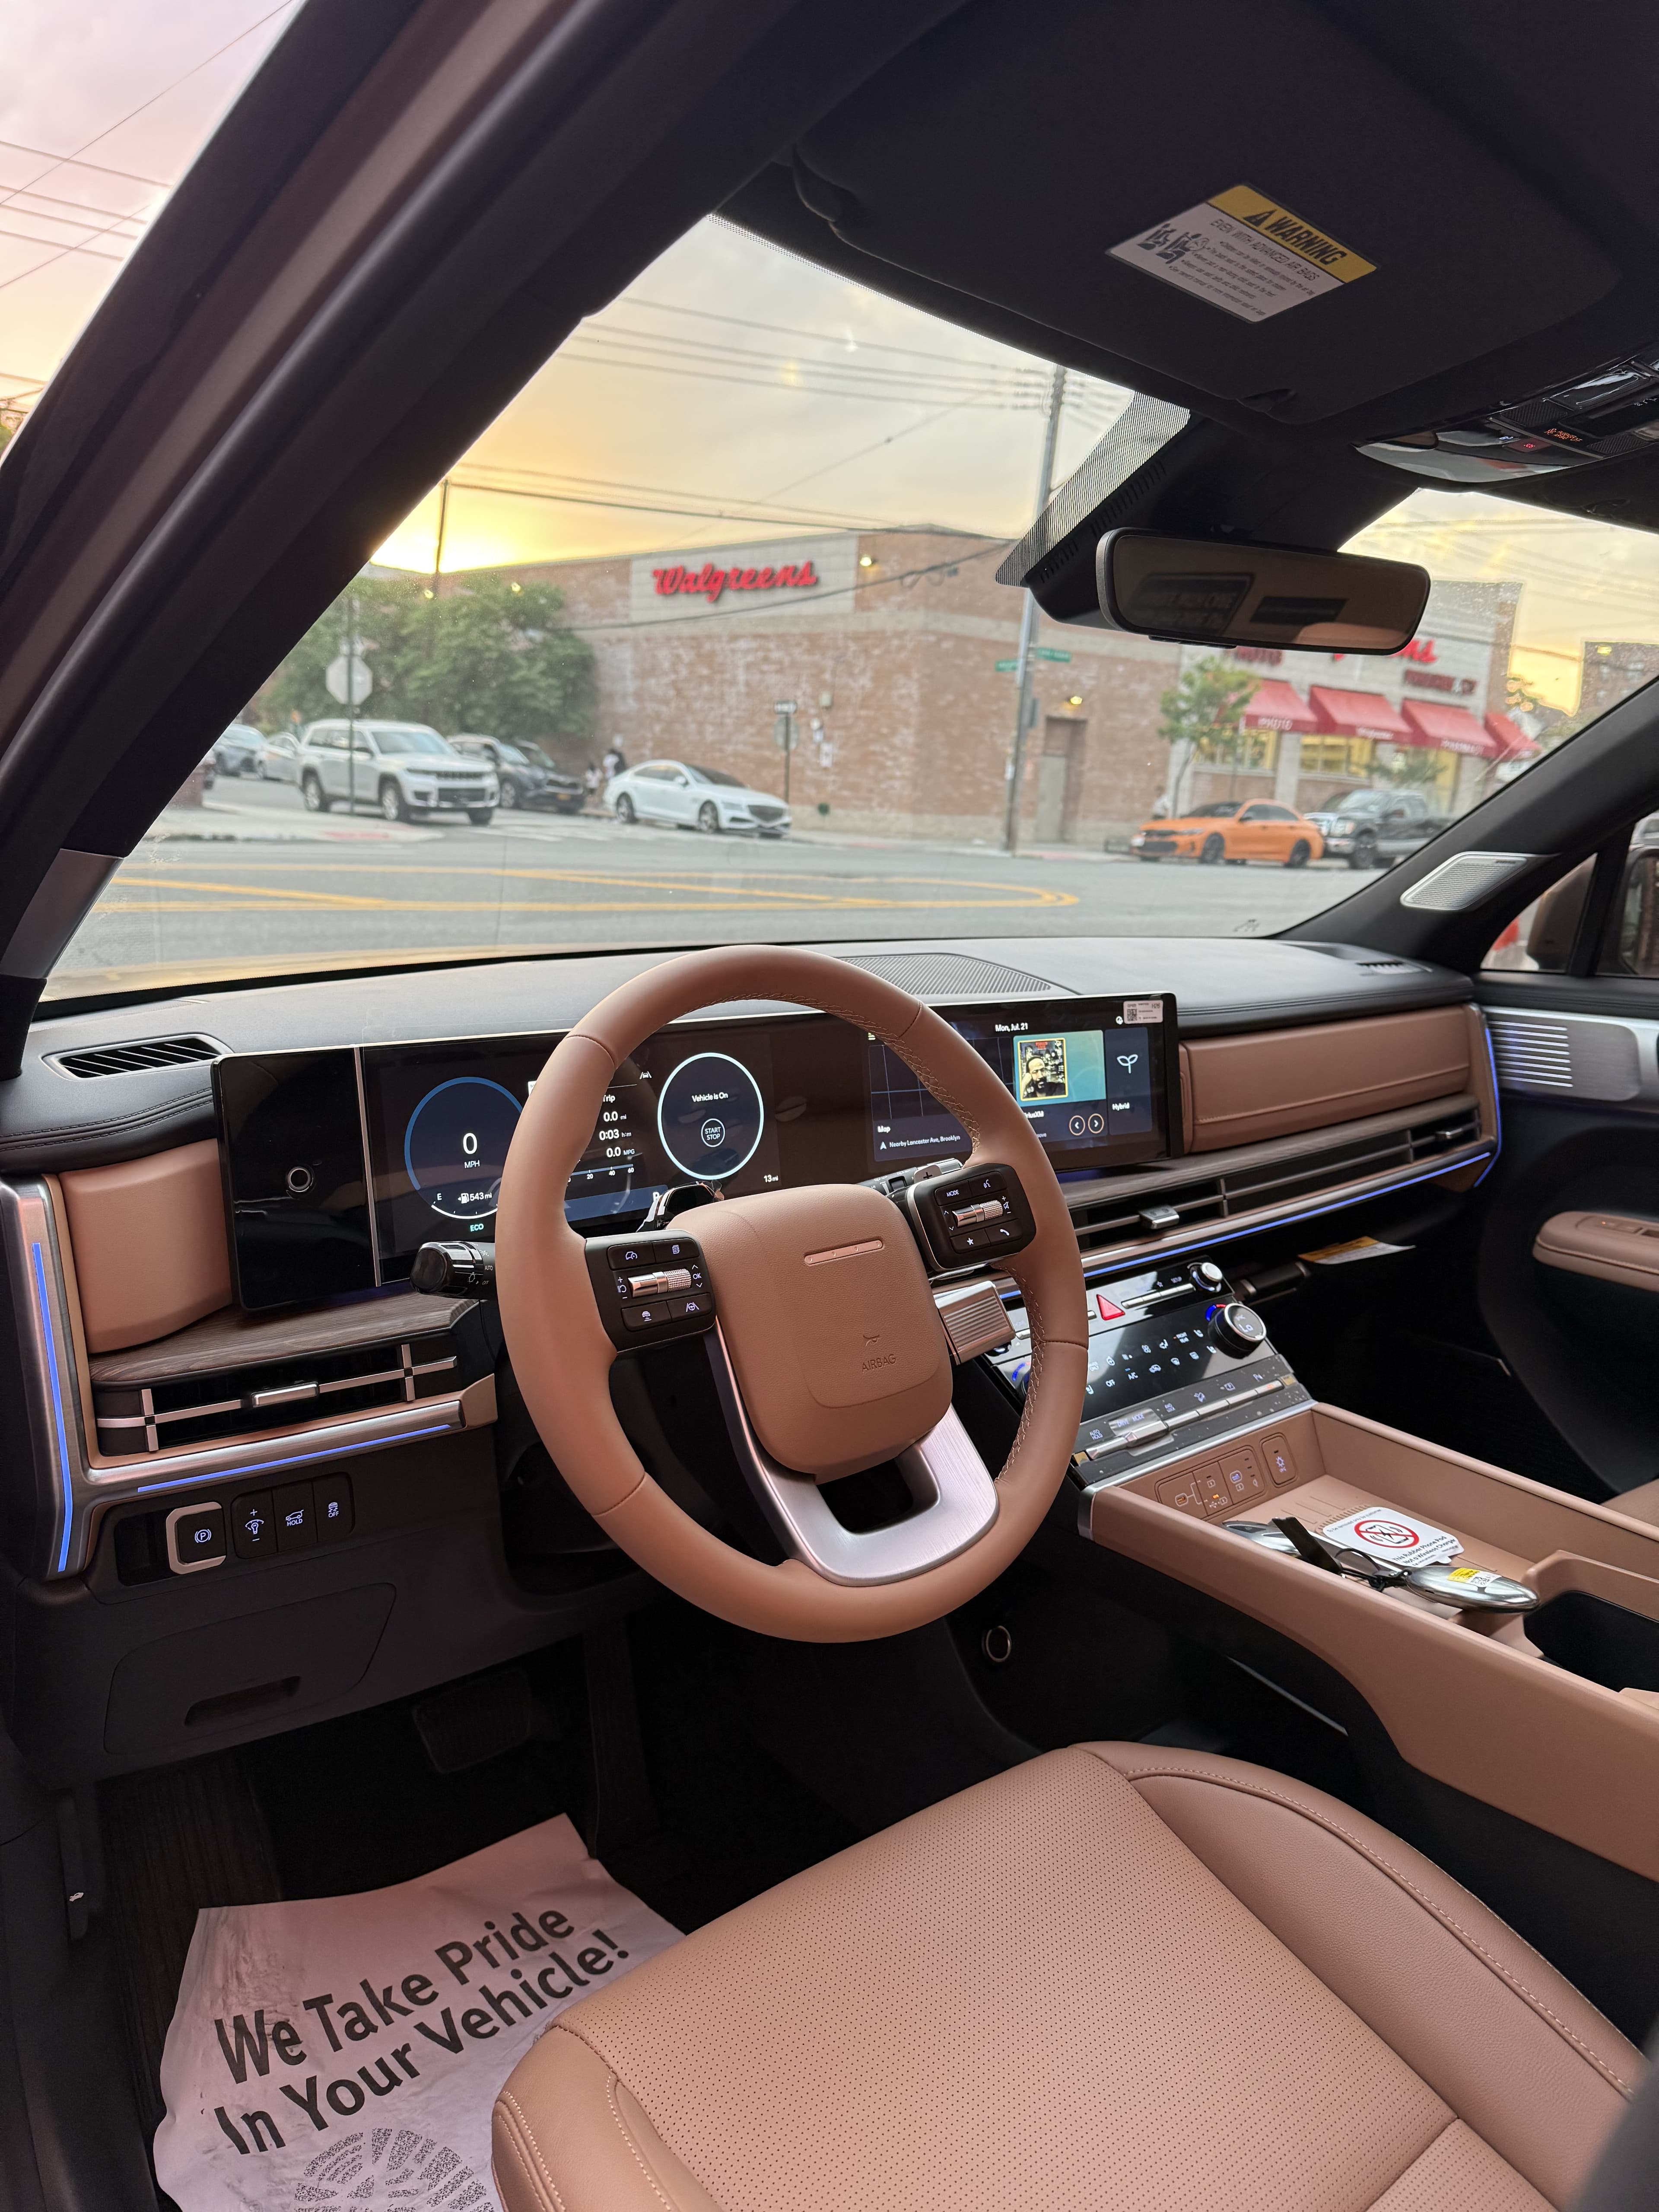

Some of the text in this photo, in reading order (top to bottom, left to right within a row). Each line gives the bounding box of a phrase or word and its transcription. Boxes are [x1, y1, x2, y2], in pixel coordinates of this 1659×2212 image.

[1264, 216, 1348, 265] WARNING
[1210, 219, 1320, 281] EVEN WITH ADVANCED AIR BAGS
[652, 560, 817, 604] Walgreens
[1112, 1103, 1130, 1111] Hybrid
[604, 1111, 618, 1122] 0.0
[599, 1129, 620, 1141] 0:03
[463, 1133, 477, 1154] 0
[606, 1147, 621, 1157] 0.0
[464, 1160, 480, 1169] MPH
[470, 1224, 484, 1232] ECO
[862, 1354, 896, 1372] AIRBAG
[1132, 1413, 1144, 1421] MODE
[214, 1909, 575, 2084] We Take Pride
[213, 1930, 629, 2155] In Your Vehicle!
